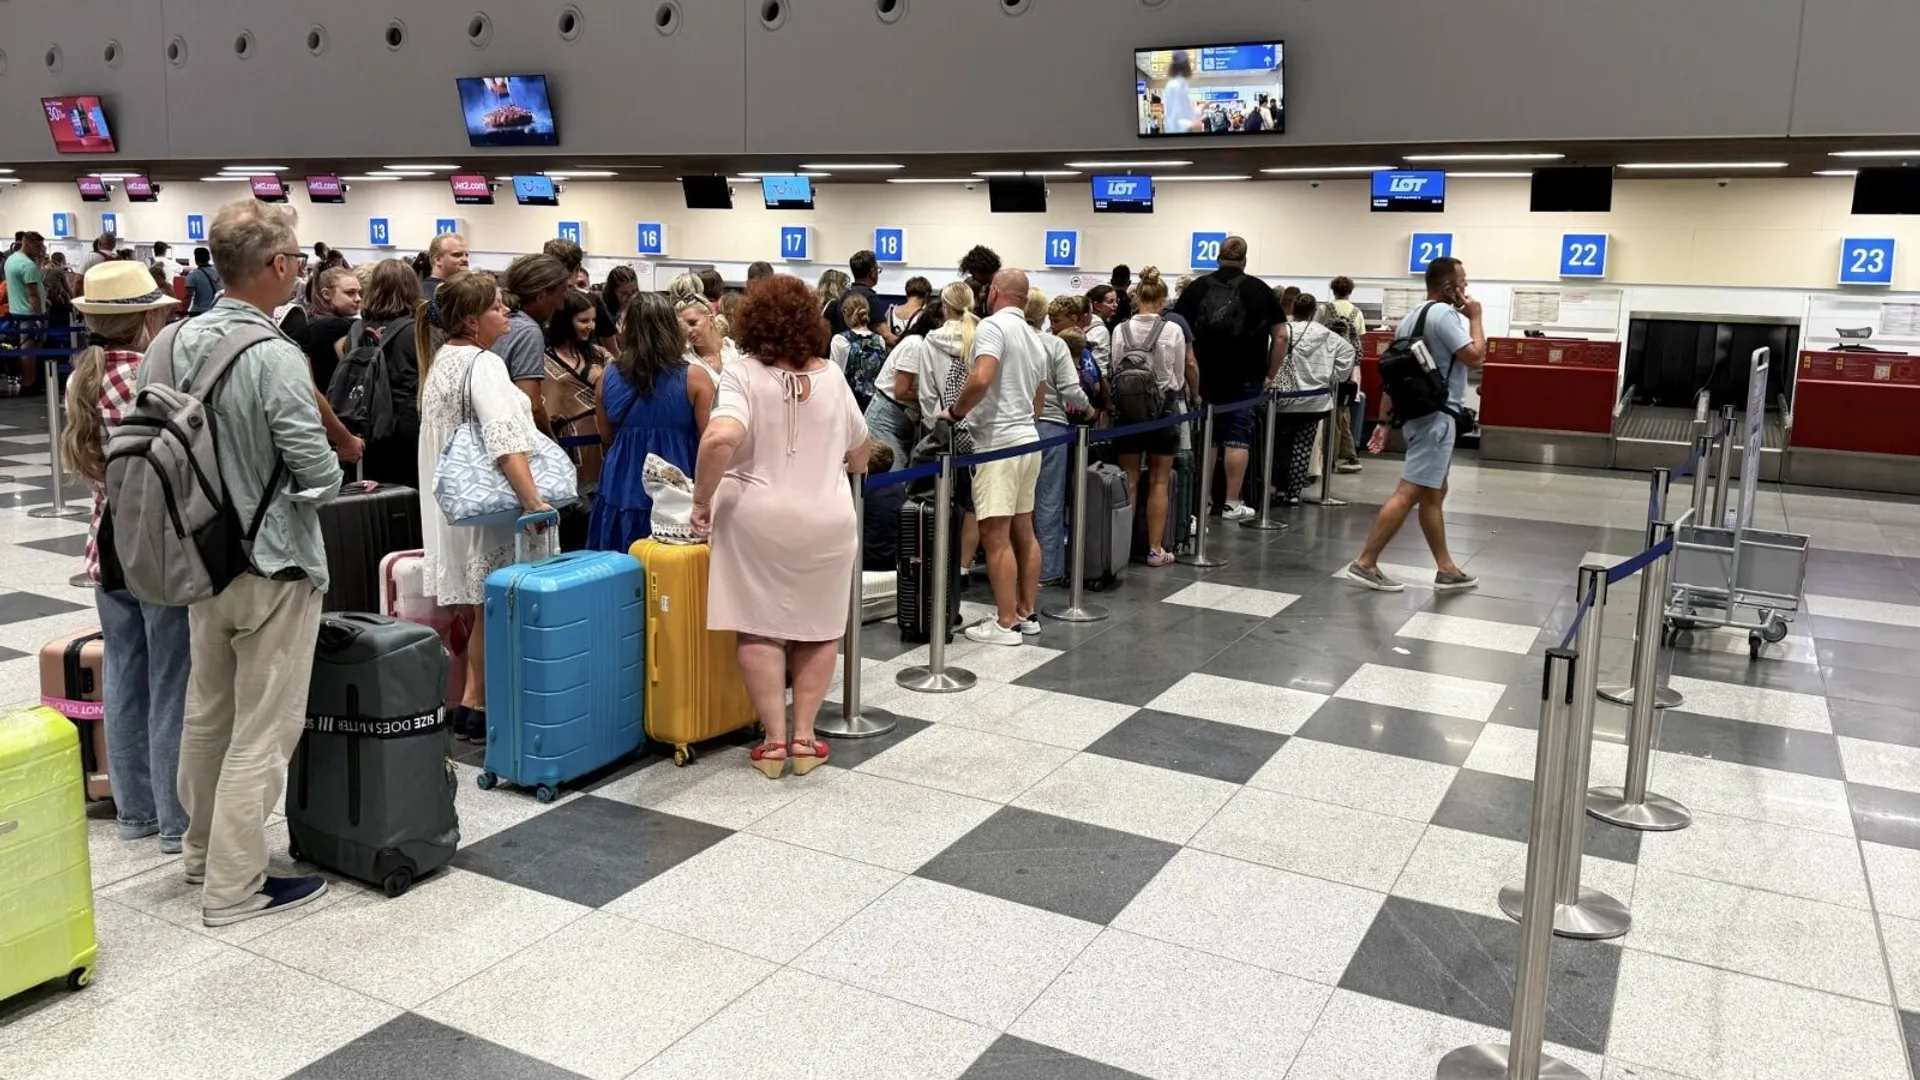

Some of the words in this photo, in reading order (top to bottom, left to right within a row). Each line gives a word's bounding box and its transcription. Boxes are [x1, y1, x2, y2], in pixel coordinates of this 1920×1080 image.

[309, 182, 338, 190] Jet2.com
[453, 181, 486, 190] Jet2.com
[1107, 182, 1137, 196] LOT
[1389, 178, 1428, 192] LOT
[57, 218, 63, 231] 9
[104, 219, 114, 232] 10
[190, 220, 201, 234] 11
[373, 224, 386, 239] 13
[562, 228, 576, 243] 15
[642, 230, 657, 248] 16
[785, 234, 802, 251] 17
[880, 236, 898, 255] 18
[1051, 239, 1070, 258] 19
[1196, 240, 1220, 261] 20
[1419, 242, 1444, 263] 21
[1568, 243, 1597, 266] 22
[1850, 248, 1885, 273] 23
[376, 720, 411, 734] DOES
[414, 714, 435, 729] SIZE
